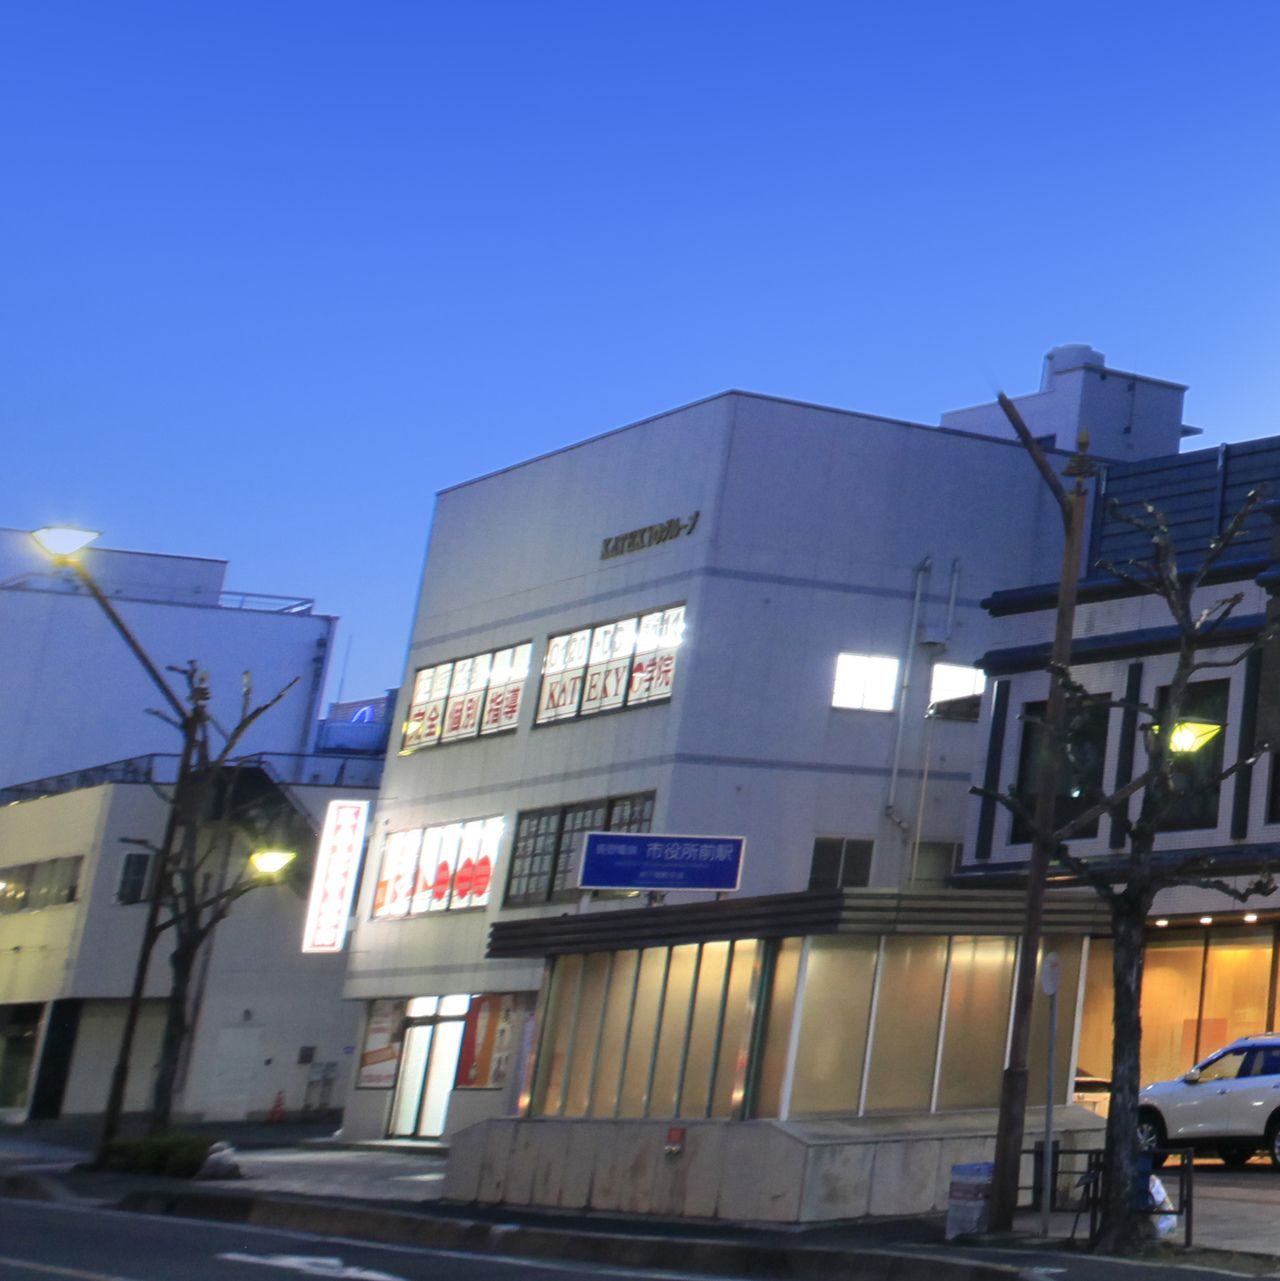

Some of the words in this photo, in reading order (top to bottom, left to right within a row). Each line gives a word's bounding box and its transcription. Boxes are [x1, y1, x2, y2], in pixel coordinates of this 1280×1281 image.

[646, 841, 735, 862] 市役所前駅
